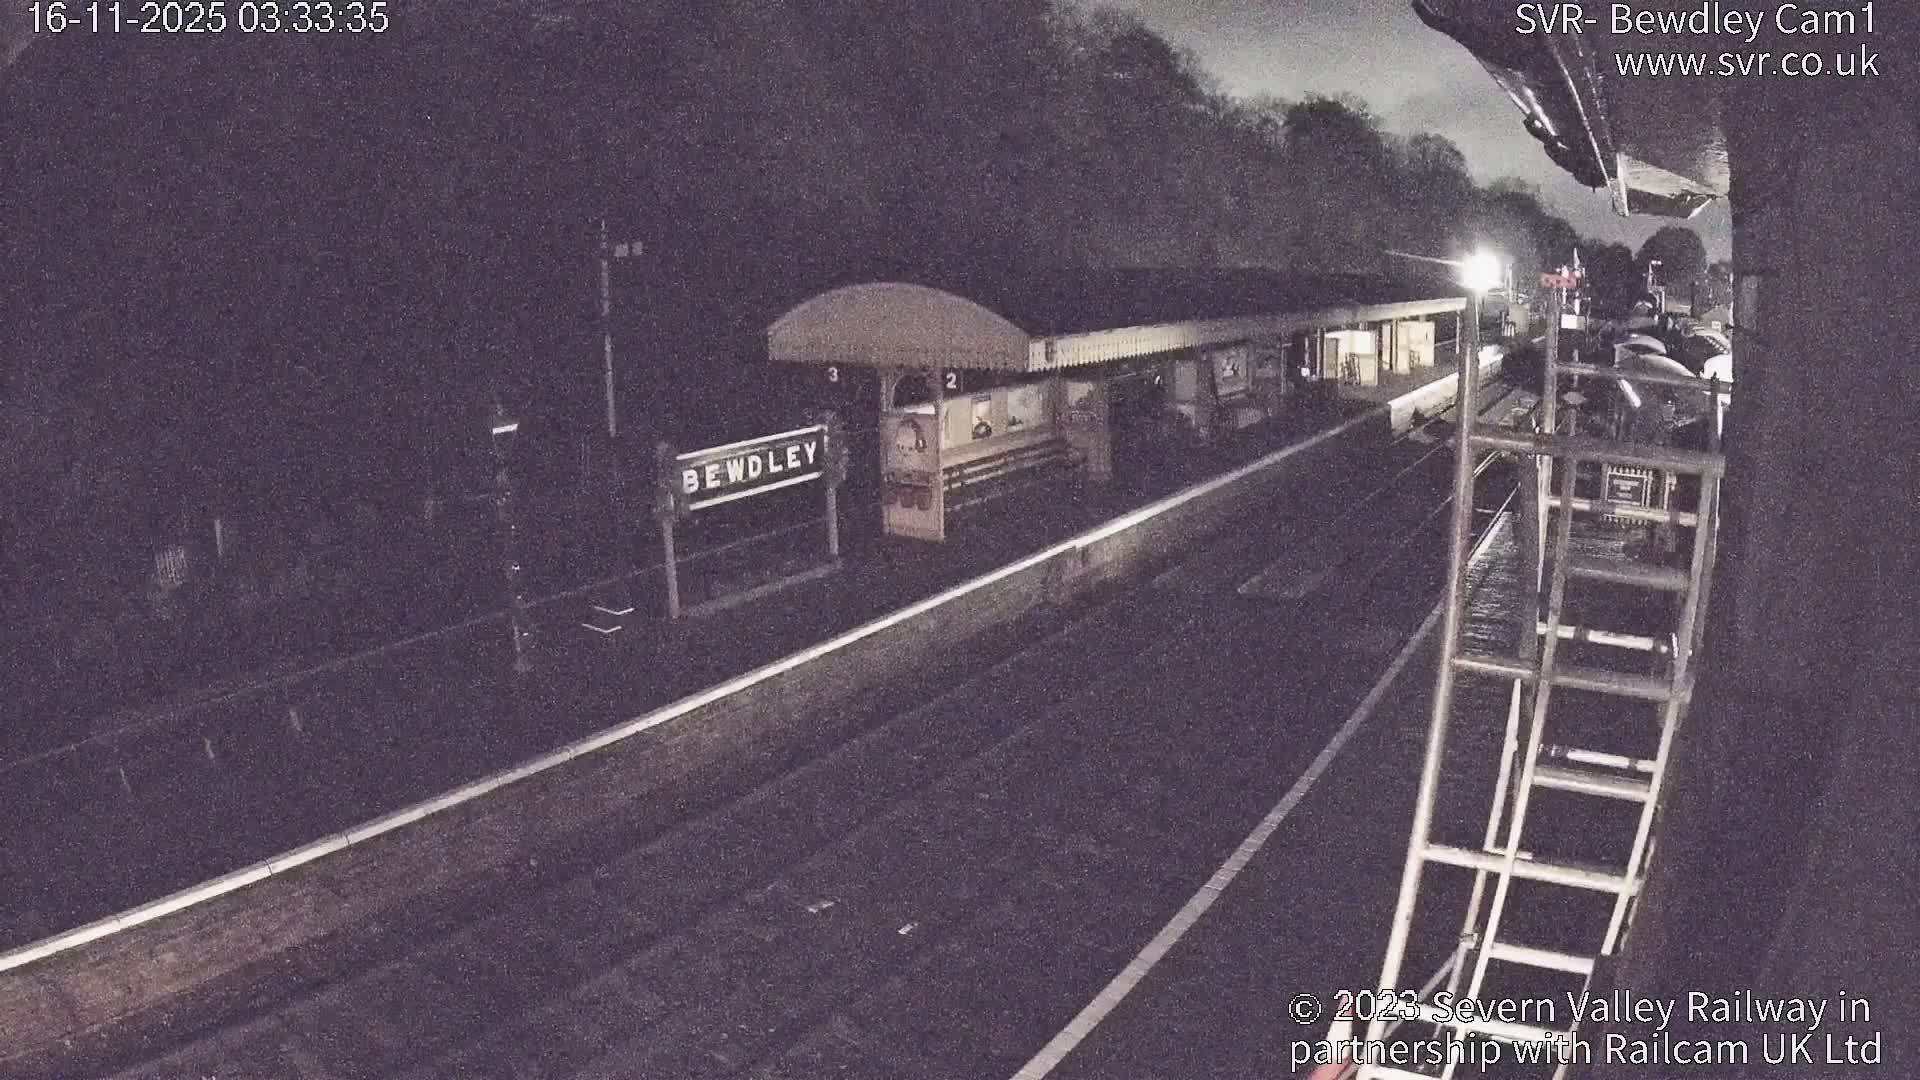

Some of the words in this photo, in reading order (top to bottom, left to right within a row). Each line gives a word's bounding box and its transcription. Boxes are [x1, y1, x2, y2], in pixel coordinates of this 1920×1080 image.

[827, 367, 838, 382] 3
[946, 373, 957, 389] 2
[682, 441, 817, 494] BEWDLEY
